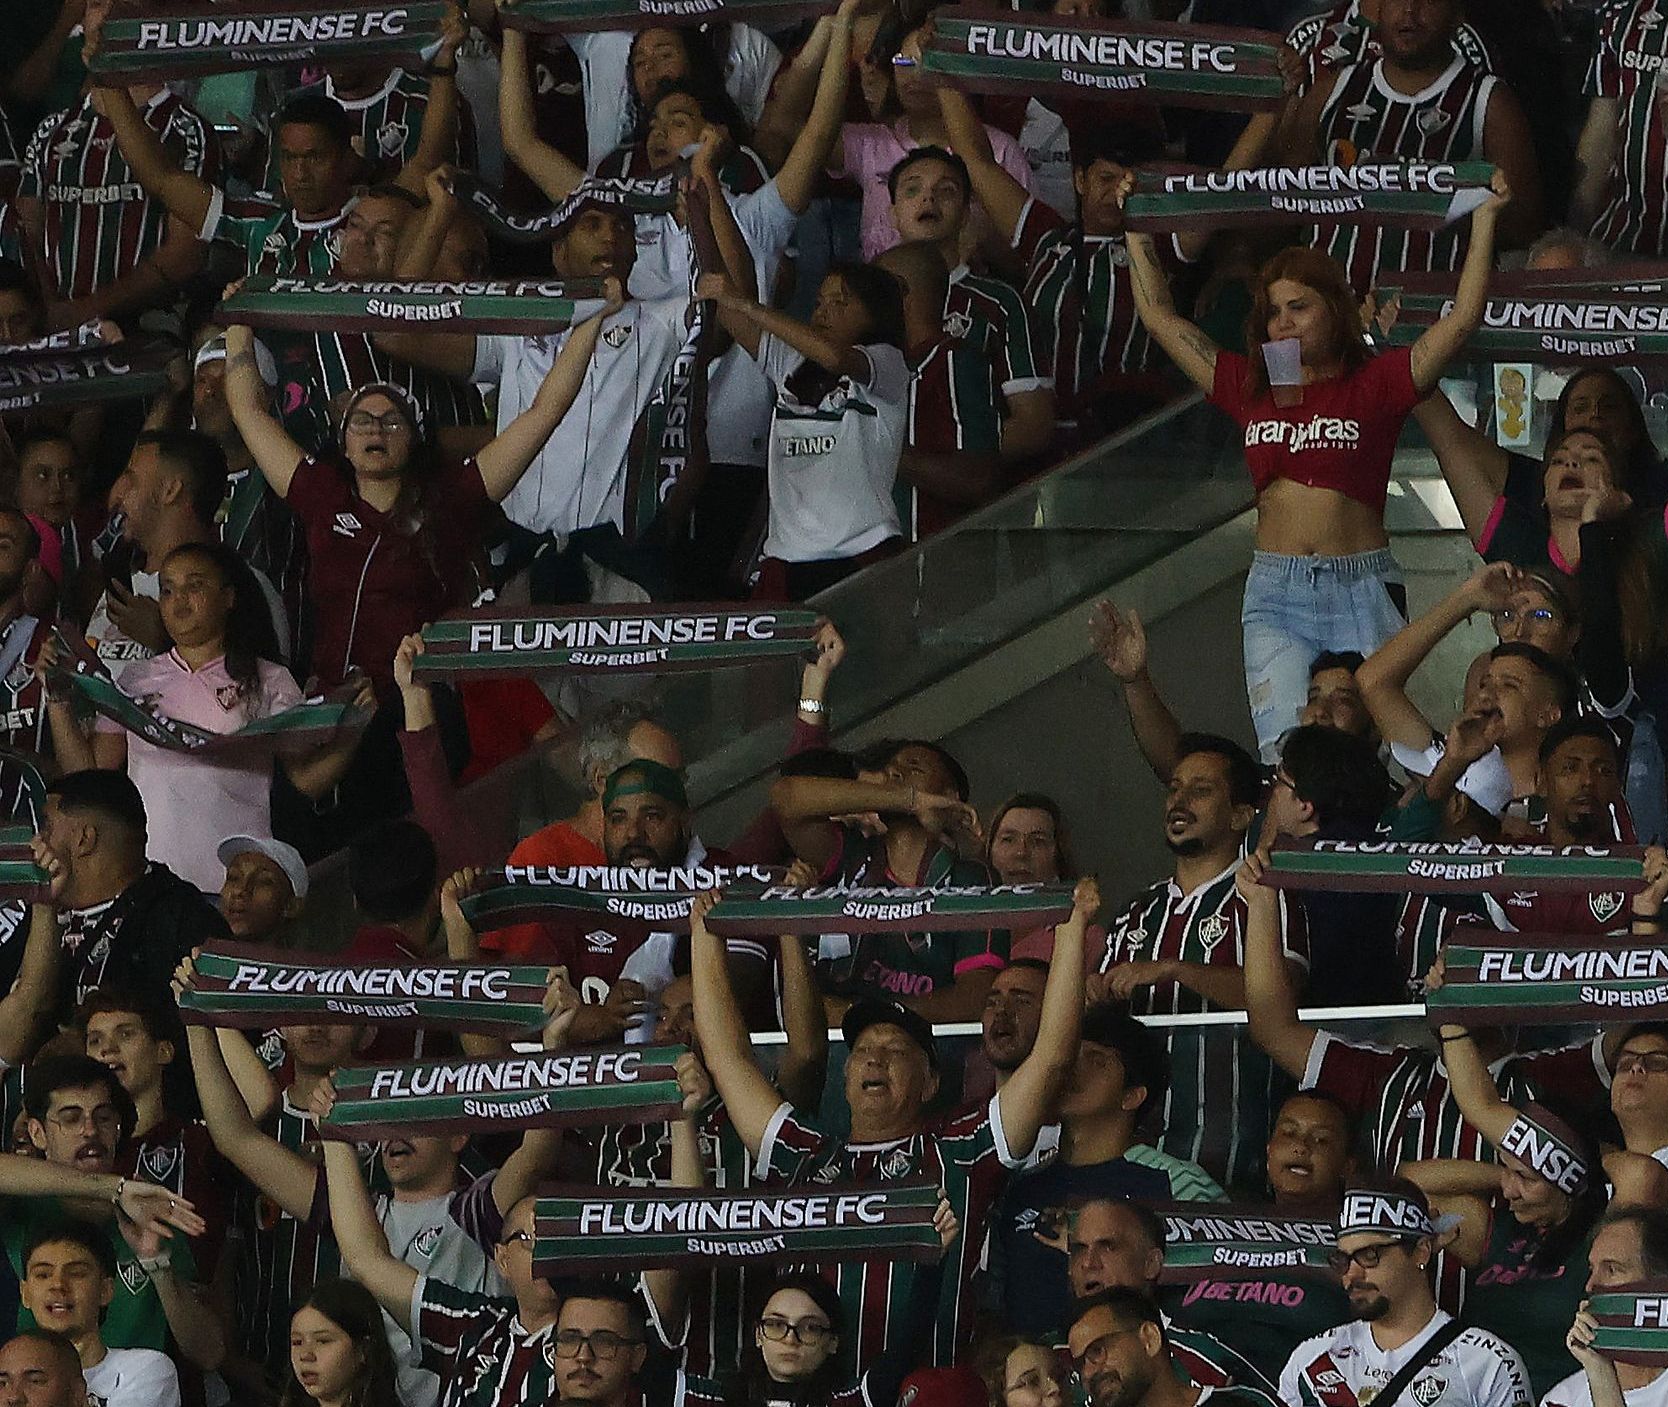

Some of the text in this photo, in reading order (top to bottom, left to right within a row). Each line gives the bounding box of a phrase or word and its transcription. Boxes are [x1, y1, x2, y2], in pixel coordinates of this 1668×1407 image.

[137, 11, 406, 48] FLUMINENSE FC
[968, 27, 1236, 73] FLUMINENSE FC
[1060, 69, 1146, 89] SUPERBET
[1408, 165, 1455, 193] FC
[47, 183, 145, 203] SUPERBET
[1270, 194, 1365, 214] SUPERBET
[366, 299, 464, 319] SUPERBET
[1542, 335, 1635, 357] SUPERBET
[470, 615, 774, 652] FLUMINENSE FC
[569, 648, 669, 665] SUPERBET
[1408, 860, 1505, 879] SUPERBET
[842, 899, 934, 921] SUPERBET
[228, 967, 509, 1000] FLUMINENSE FC
[327, 999, 419, 1018] SUPERBET
[371, 1052, 640, 1098] FLUMINENSE FC
[464, 1095, 552, 1118] SUPERBET
[579, 1194, 886, 1235] FLUMINENSE FC
[687, 1234, 785, 1256] SUPERBET
[1213, 1248, 1306, 1268] SUPERBET
